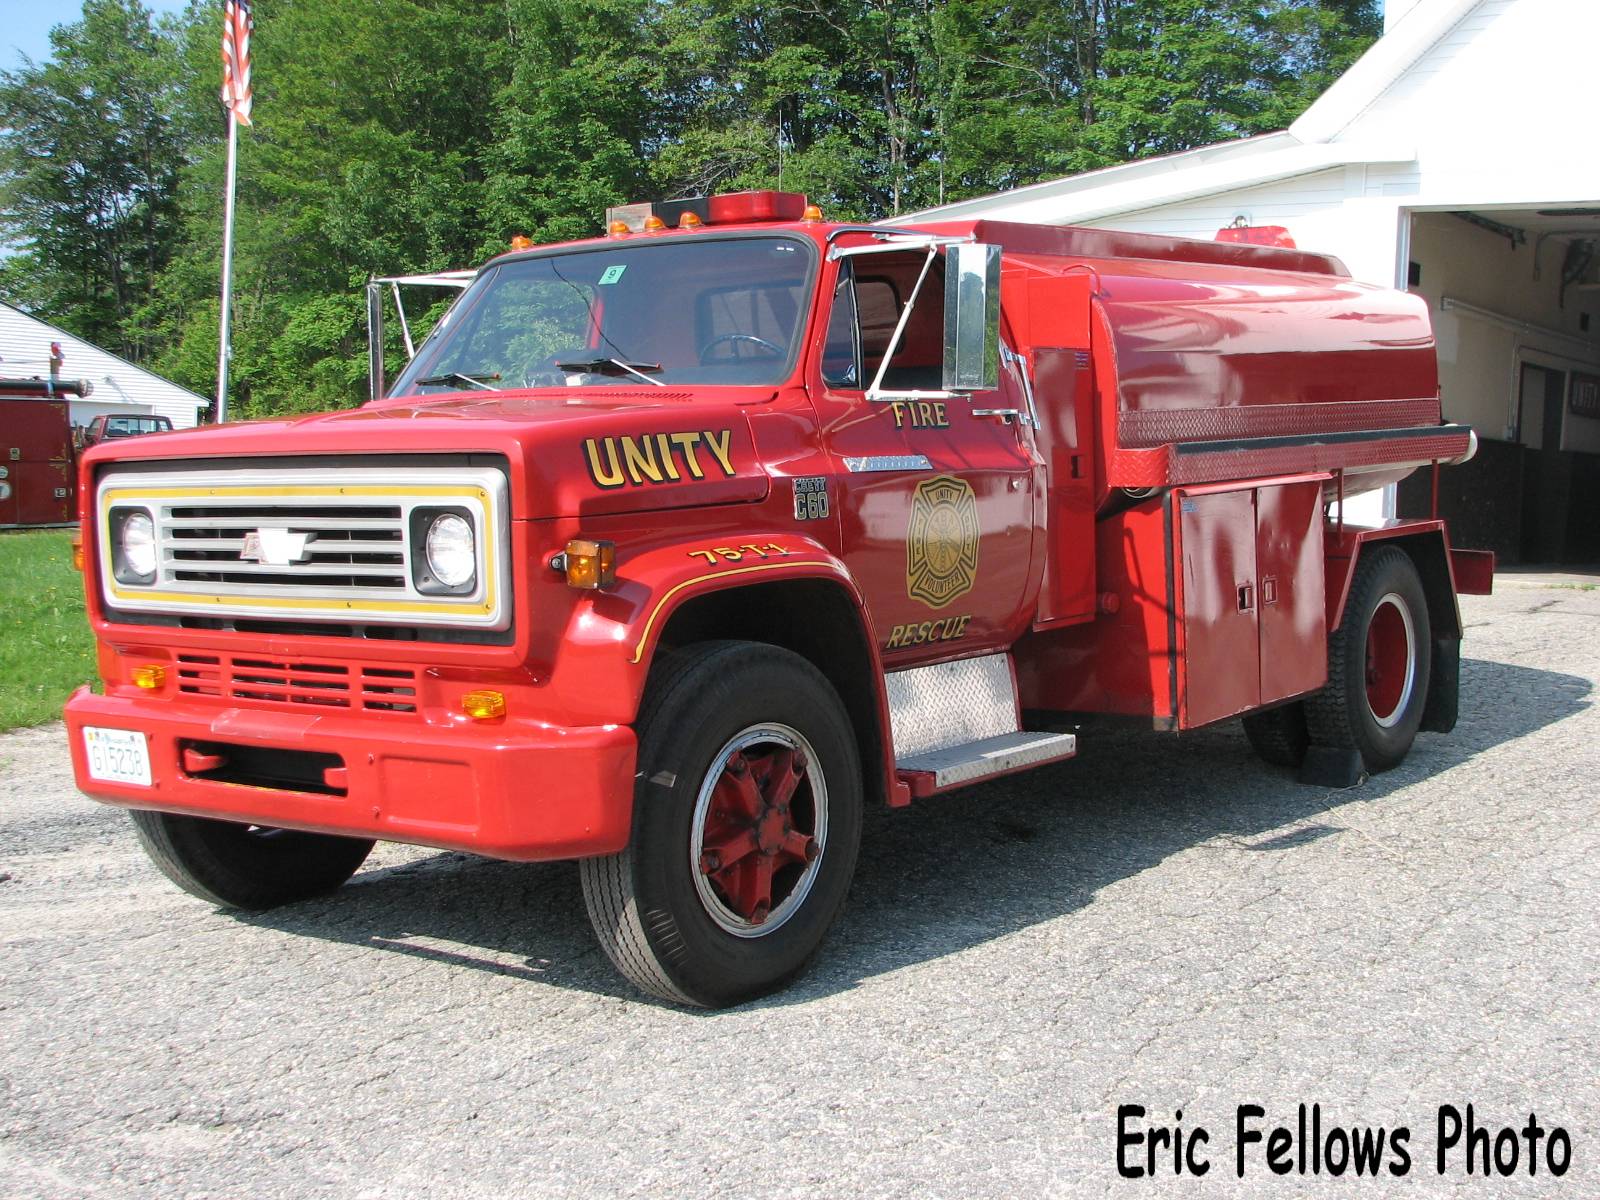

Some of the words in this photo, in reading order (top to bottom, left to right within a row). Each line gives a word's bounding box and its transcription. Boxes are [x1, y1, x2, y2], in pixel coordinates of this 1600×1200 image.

[892, 402, 950, 430] FIRE
[582, 429, 736, 489] UNITY
[796, 492, 829, 519] C60
[935, 488, 954, 501] UNITY
[923, 573, 961, 594] VOLUNTEER
[885, 615, 972, 649] RESCUE
